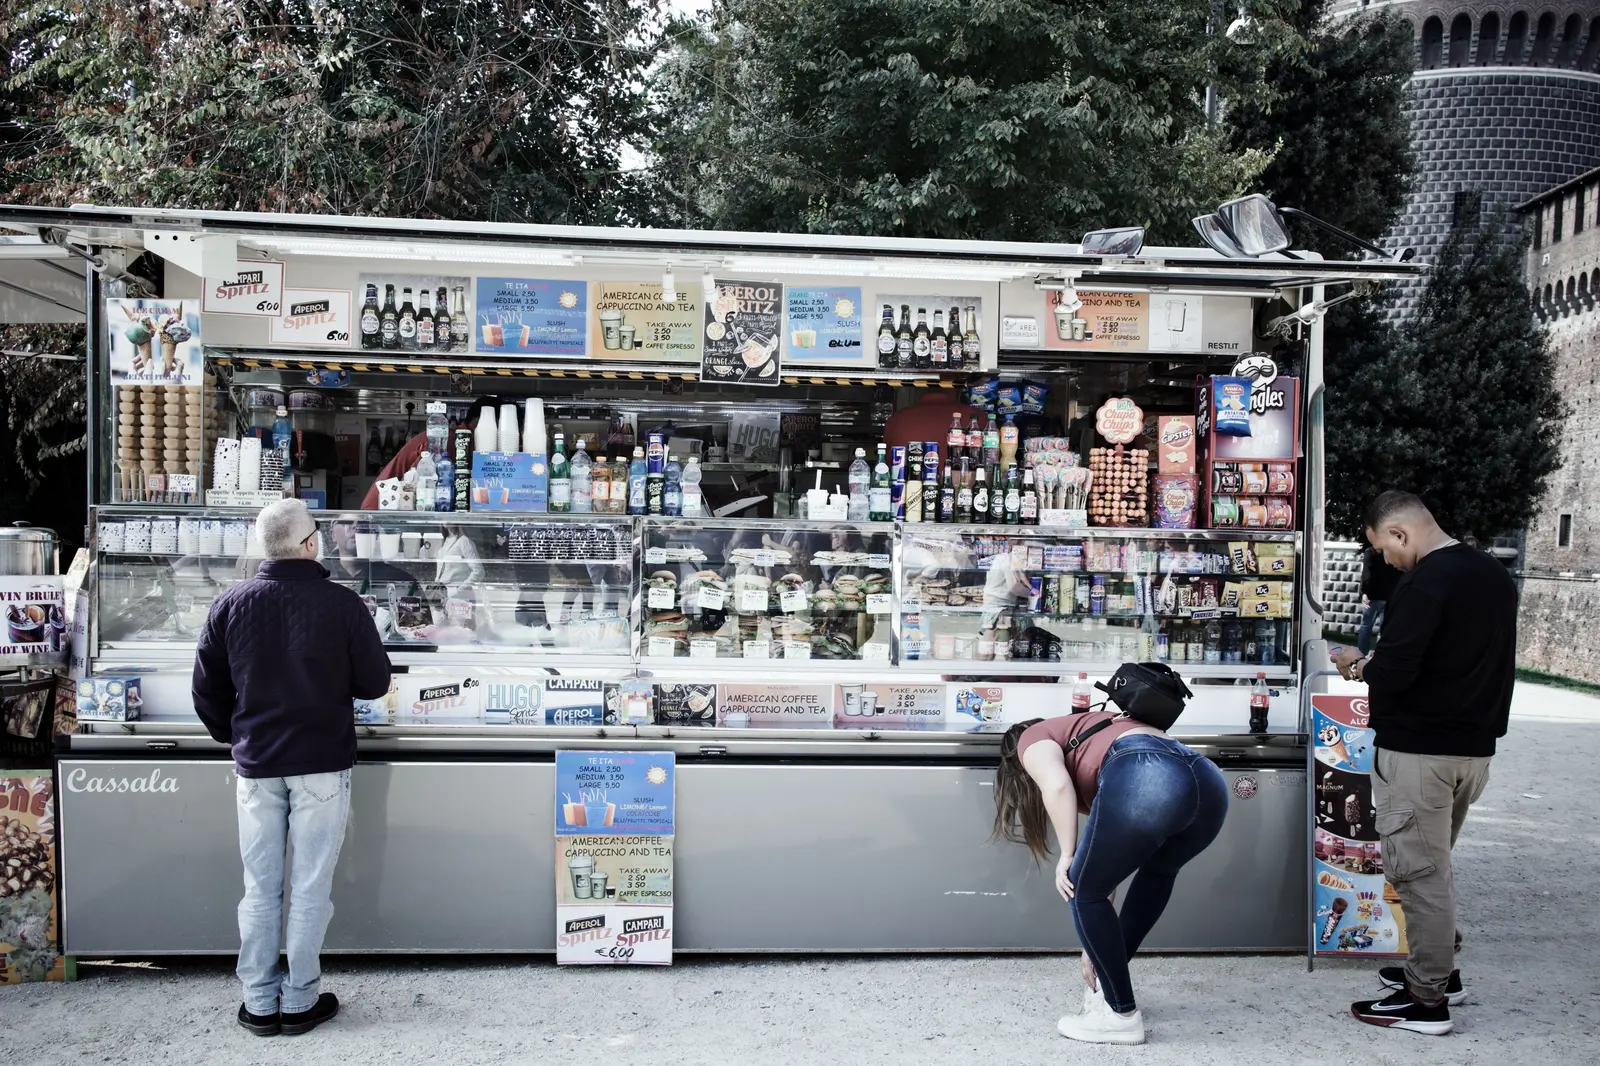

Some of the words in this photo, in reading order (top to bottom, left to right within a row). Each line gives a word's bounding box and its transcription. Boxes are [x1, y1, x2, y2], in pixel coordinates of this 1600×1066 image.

[216, 281, 270, 300] Spritz
[602, 292, 651, 300] AMERICAN
[294, 302, 326, 315] APEROL
[596, 302, 653, 312] CAPPUCCINO
[678, 303, 695, 311] TEA
[283, 312, 336, 330] Spritz
[1208, 342, 1239, 350] RESTI.IT
[705, 357, 727, 365] ORANGE
[1250, 386, 1284, 412] ngles
[1104, 409, 1135, 419] Chupa
[1102, 419, 1134, 430] Chups
[1161, 428, 1194, 444] CIPSTER
[21, 645, 50, 654] WINE
[548, 679, 600, 690] CAMPARI
[423, 687, 456, 700] APEROL
[488, 684, 541, 709] HUGO
[726, 694, 779, 703] AMERICAN
[781, 695, 818, 703] COFFEE
[412, 696, 467, 716] Spritz
[720, 705, 781, 715] CAPPUCCINO
[784, 706, 804, 714] AND
[808, 706, 826, 714] TEA
[554, 708, 594, 720] APEROL
[66, 768, 180, 793] Cassala
[572, 837, 624, 846] AMERICAN
[626, 836, 662, 845] COFFEE
[565, 848, 627, 857] CAPPUCCINO
[629, 848, 650, 856] AND
[654, 848, 672, 856] TEA
[569, 919, 602, 931] APEROL
[625, 918, 662, 931] CAMPARI
[558, 927, 613, 948] Spritz
[615, 927, 671, 947] Spritz
